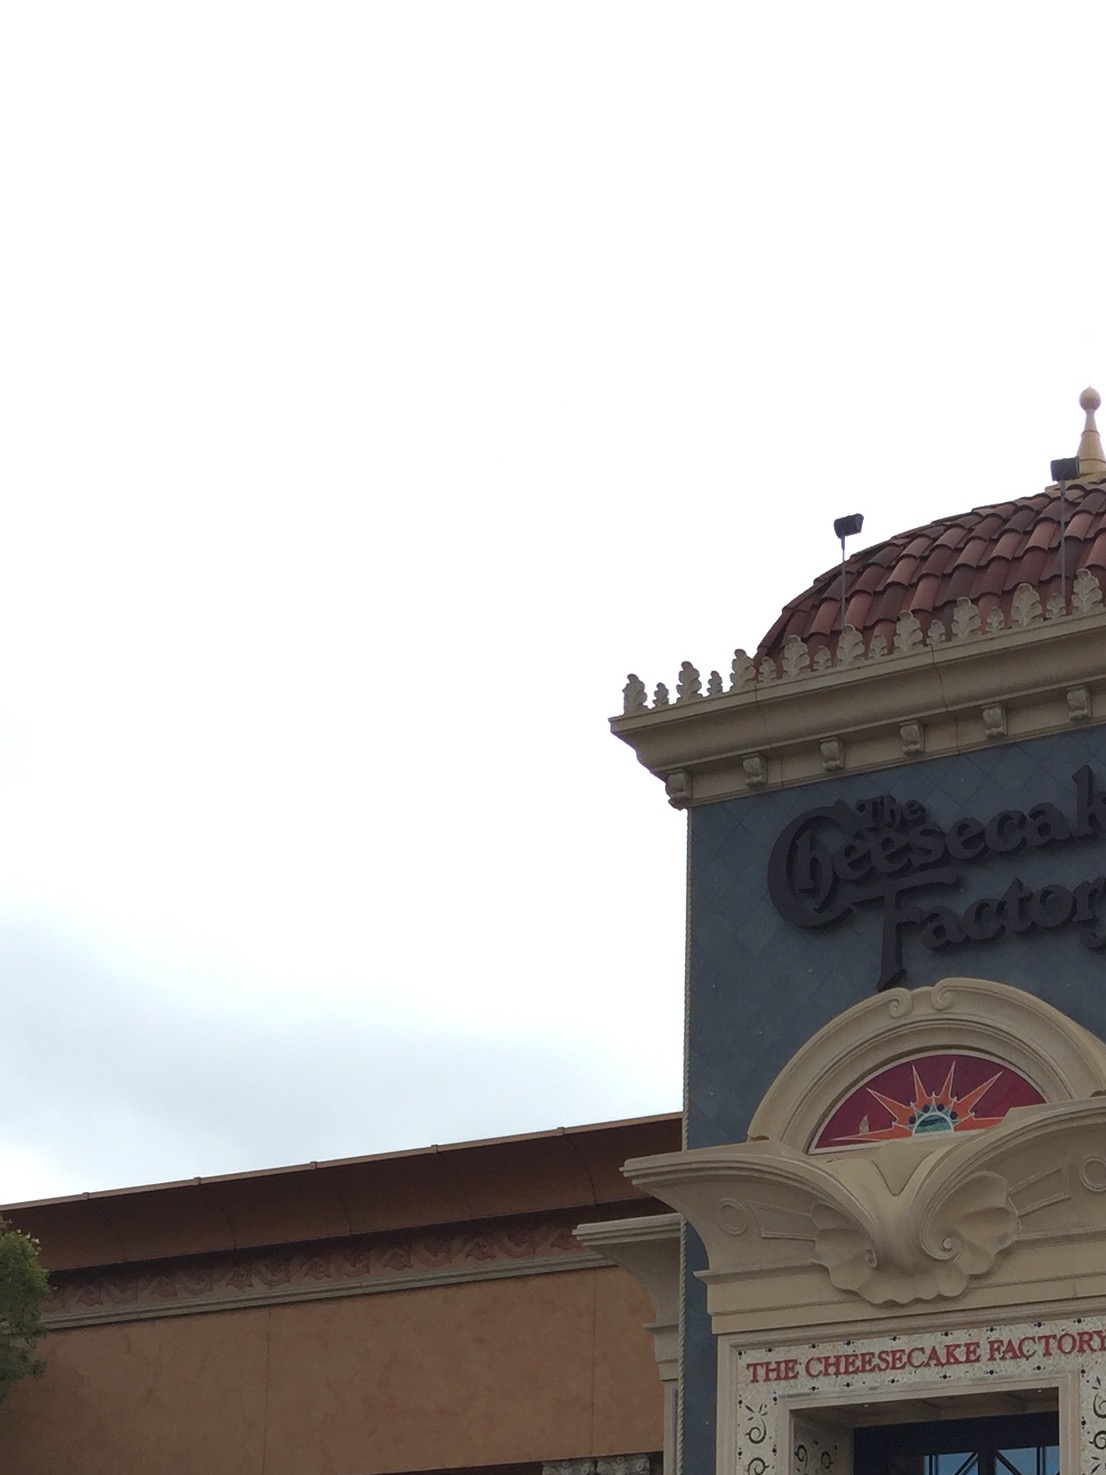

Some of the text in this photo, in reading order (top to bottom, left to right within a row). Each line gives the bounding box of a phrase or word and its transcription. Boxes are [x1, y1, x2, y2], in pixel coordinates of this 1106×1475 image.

[856, 793, 928, 831] The
[747, 1360, 800, 1384] THE
[805, 1341, 981, 1378] CHEESECAKE
